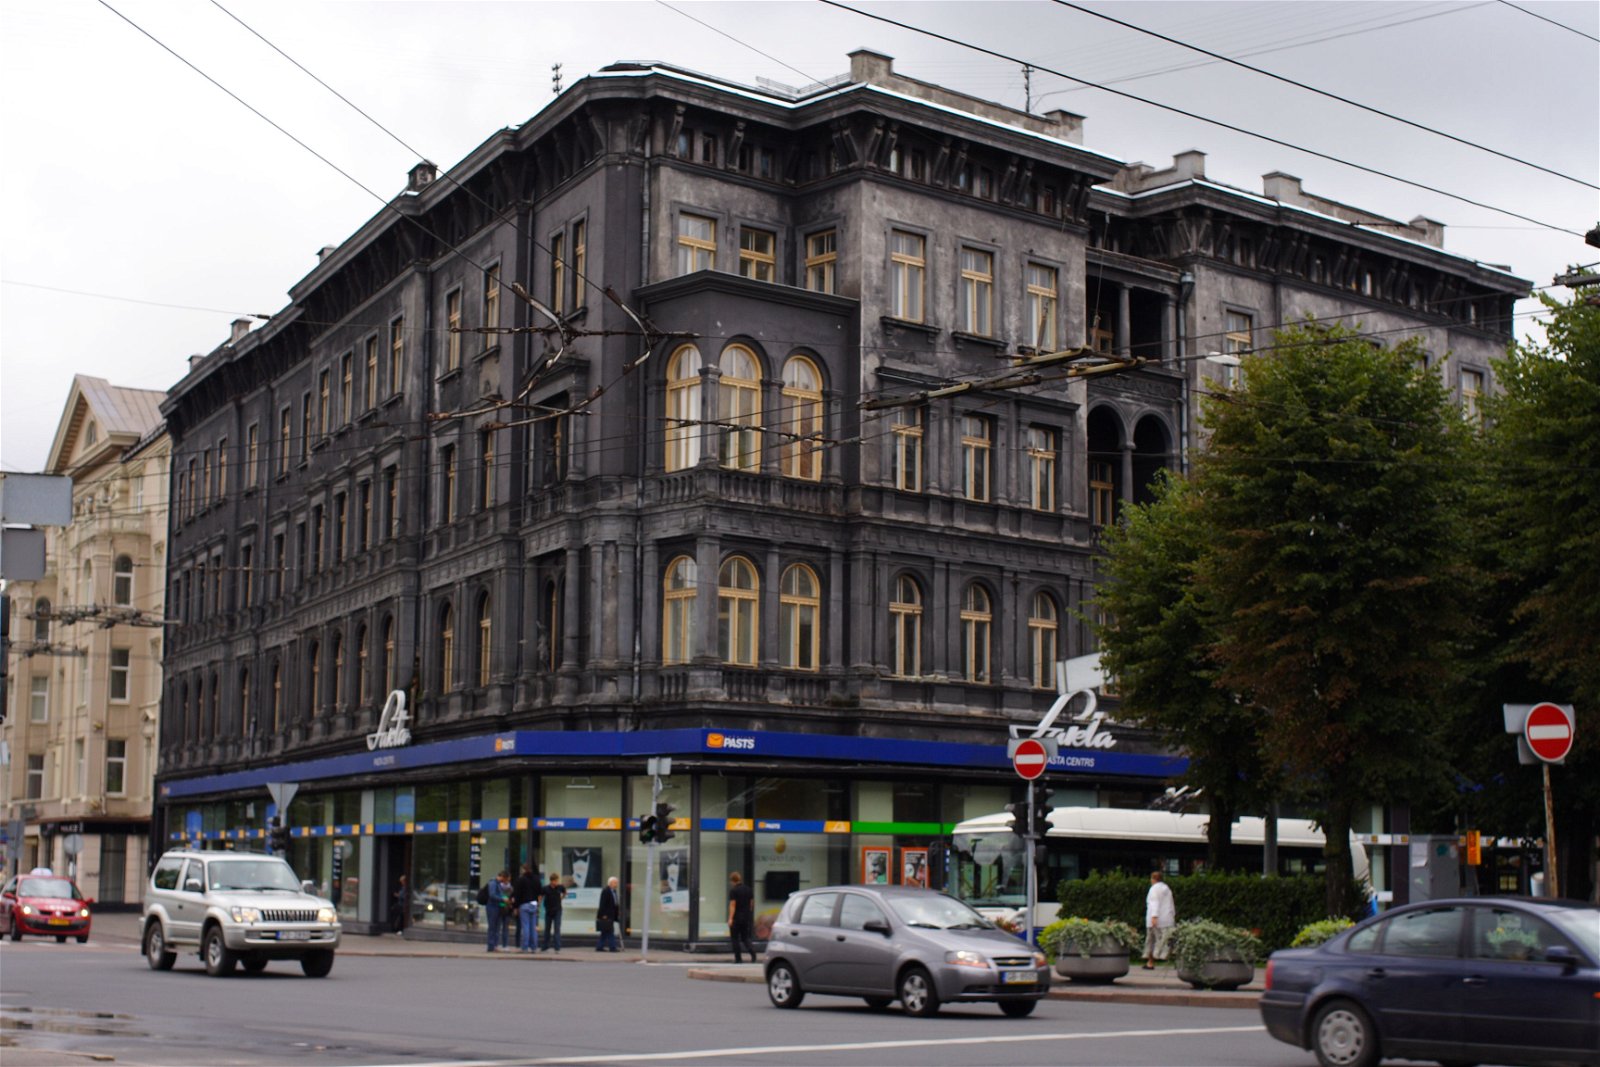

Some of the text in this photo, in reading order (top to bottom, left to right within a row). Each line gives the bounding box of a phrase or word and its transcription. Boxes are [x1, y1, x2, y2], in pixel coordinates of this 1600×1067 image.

[723, 737, 755, 749] PASTS
[1046, 756, 1095, 768] ASTA CENTRS
